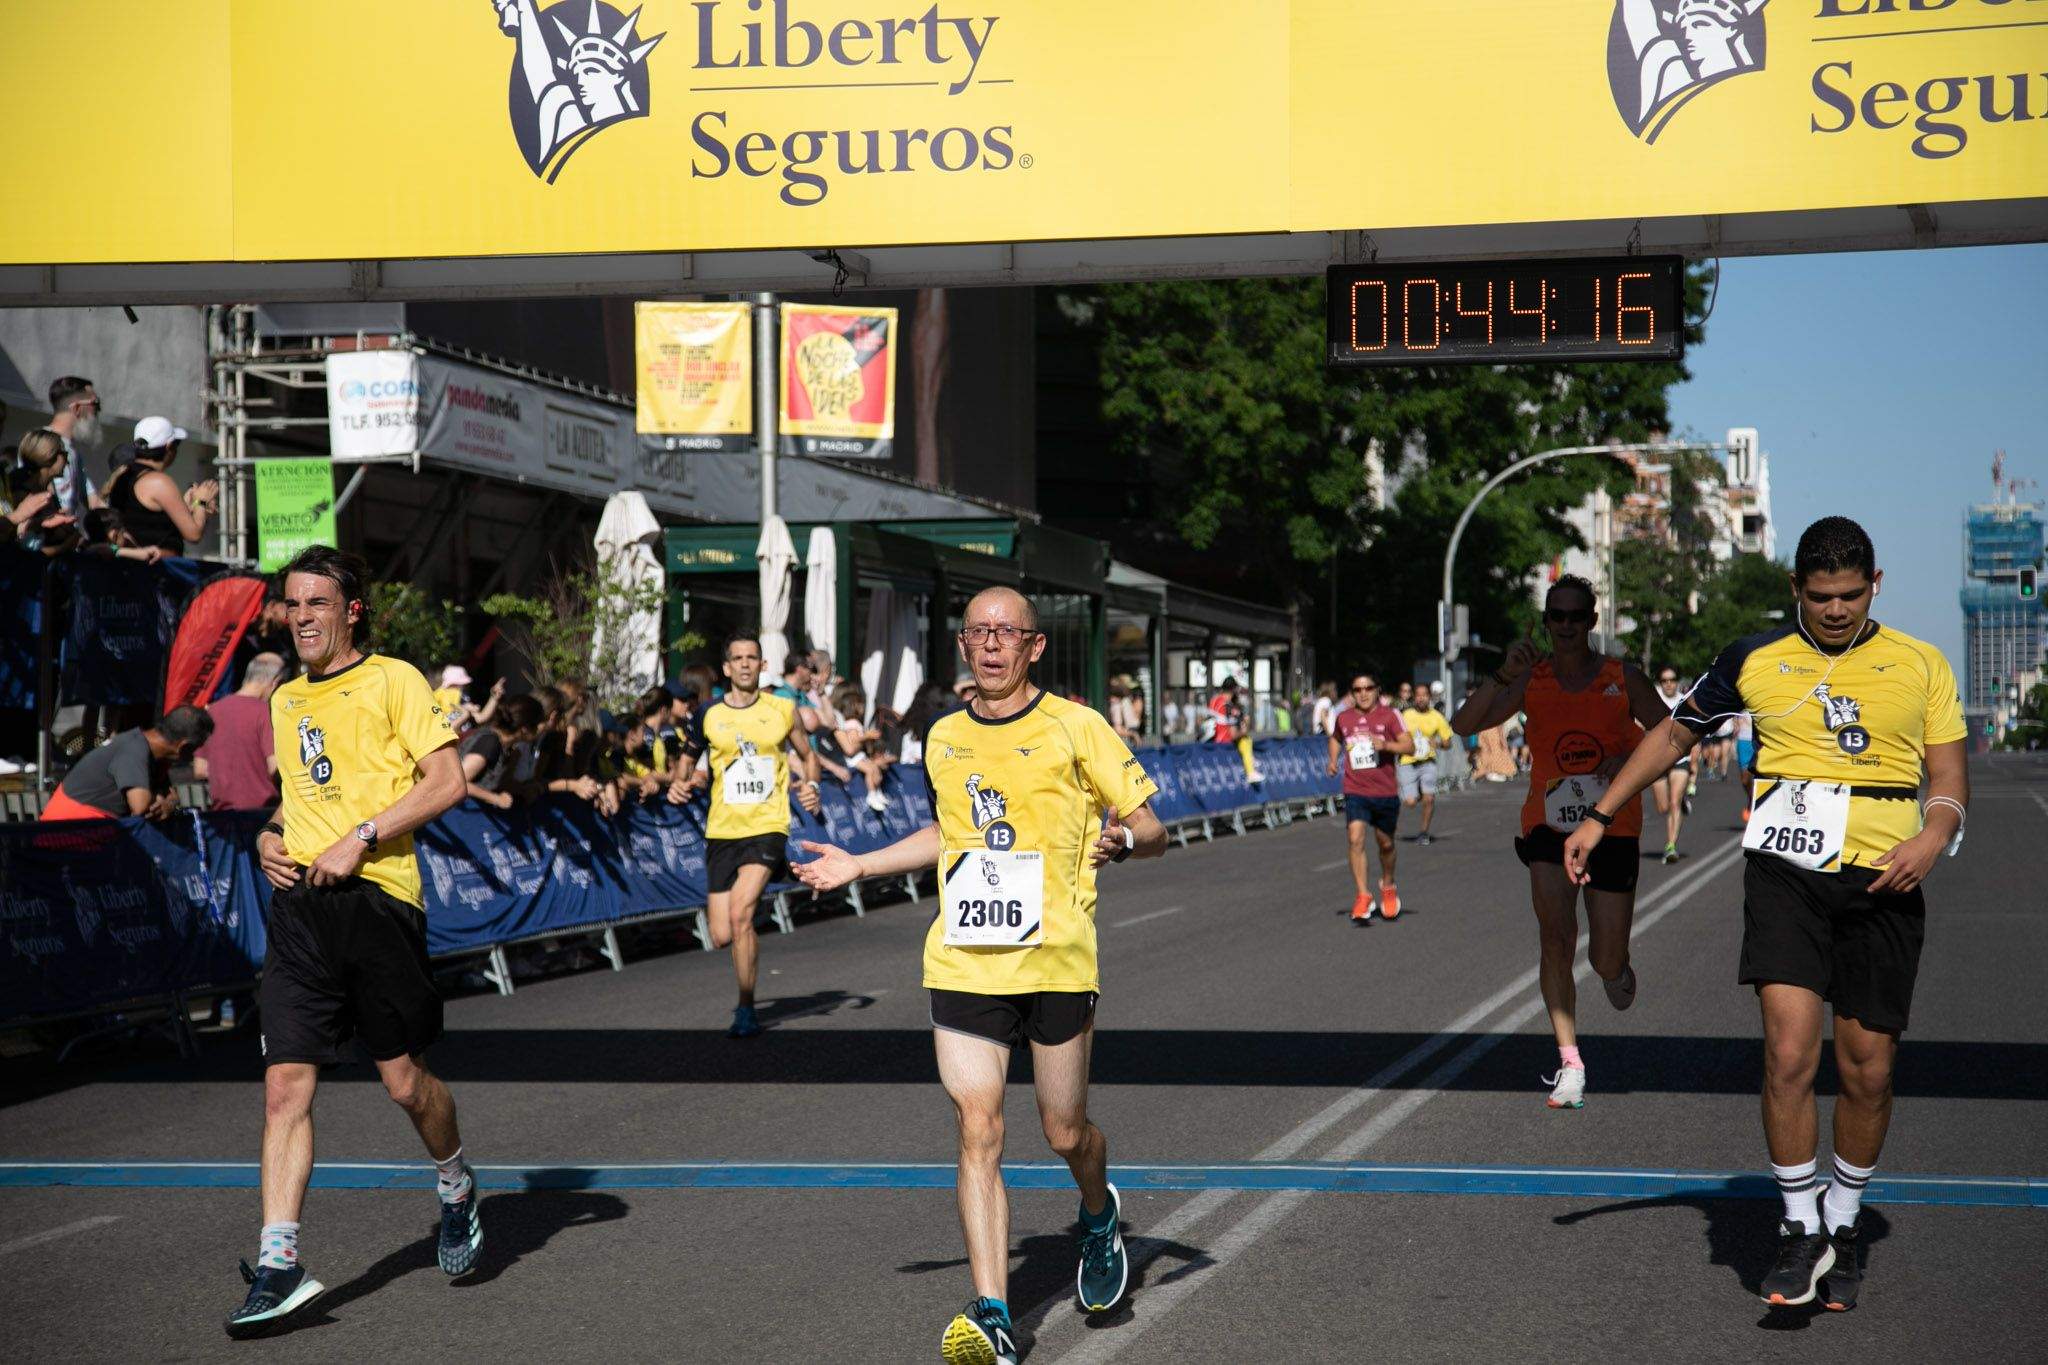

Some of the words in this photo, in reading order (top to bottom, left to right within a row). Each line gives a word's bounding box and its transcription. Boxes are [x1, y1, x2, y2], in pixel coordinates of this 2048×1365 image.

[690, 0, 1000, 96] Liberty
[1811, 61, 2048, 160] Segu
[1351, 272, 1656, 352] 00:44:16
[1843, 731, 1864, 748] 13
[316, 762, 330, 779] 13
[1851, 757, 1882, 768] Liberty
[736, 781, 764, 795] 1149
[1560, 805, 1598, 823] 152
[990, 828, 1010, 846] 13
[1760, 826, 1825, 855] 2663
[958, 899, 1022, 928] 2306
